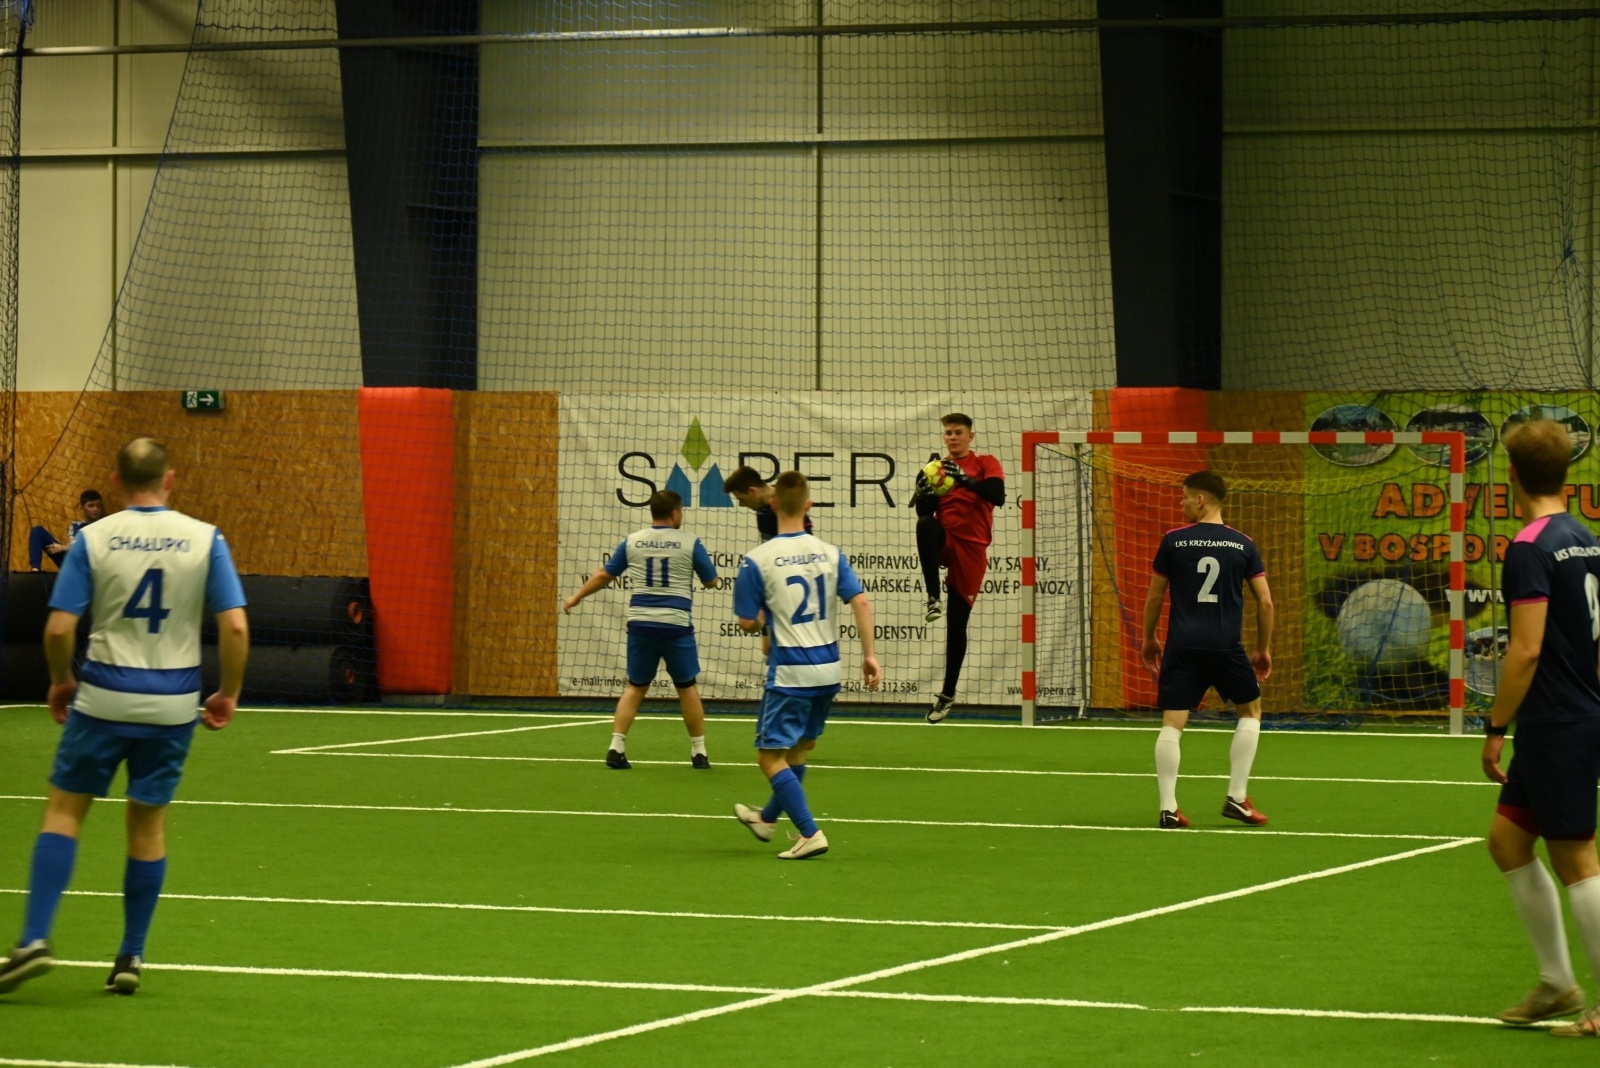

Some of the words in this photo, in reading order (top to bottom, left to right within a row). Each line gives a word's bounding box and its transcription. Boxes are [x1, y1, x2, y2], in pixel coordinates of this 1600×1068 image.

[108, 536, 190, 553] CHAŁUPKI
[635, 540, 682, 550] CHAŁUPKI
[1189, 539, 1245, 551] KRZYŻANOWICE
[1319, 533, 1345, 561] V
[1353, 533, 1514, 562] BOSPOR
[645, 556, 670, 588] 11
[1006, 556, 1051, 573] SANY,
[1197, 556, 1220, 603] 2
[122, 568, 172, 634] 4
[785, 574, 826, 626] 21
[840, 623, 927, 640] PODENSTVÍ
[882, 682, 898, 693] 312
[900, 682, 918, 693] 536
[1007, 686, 1076, 698] wwypera.cz
